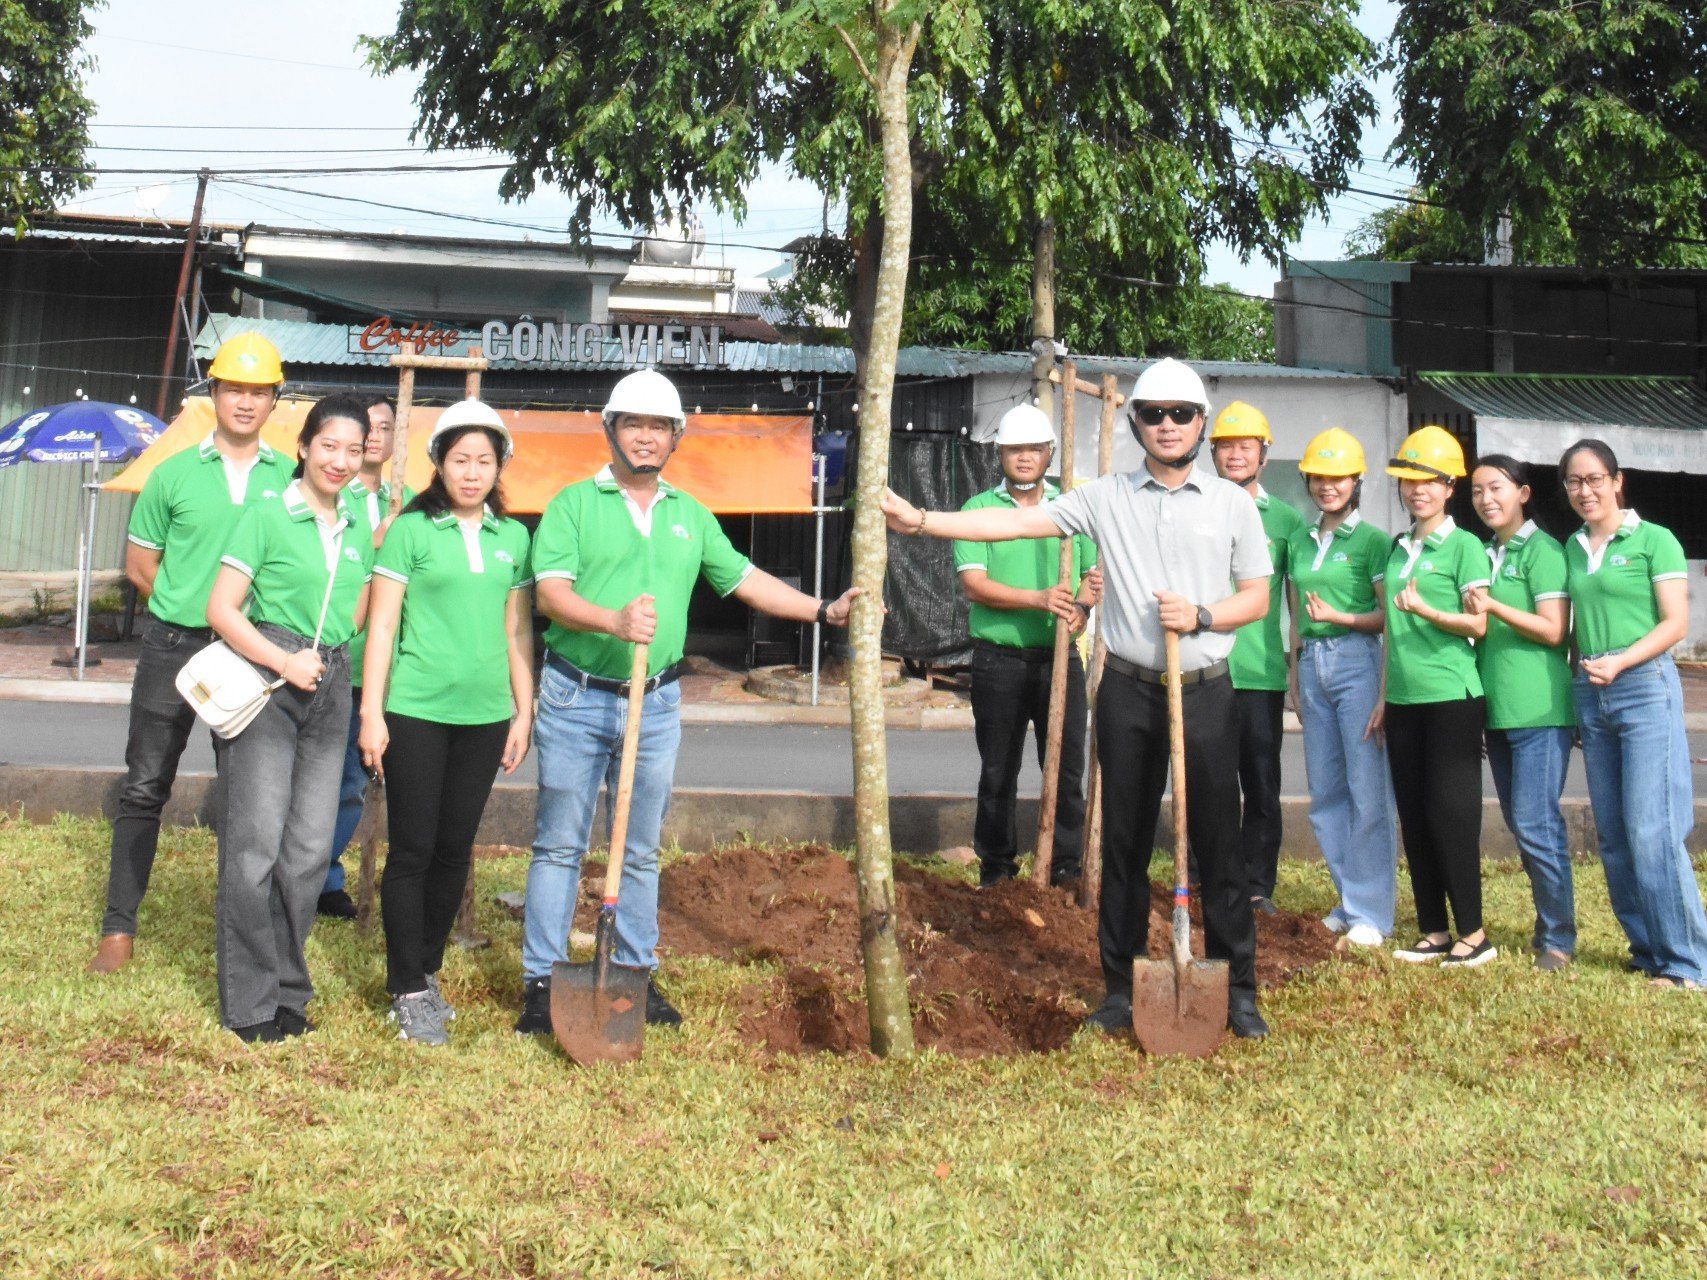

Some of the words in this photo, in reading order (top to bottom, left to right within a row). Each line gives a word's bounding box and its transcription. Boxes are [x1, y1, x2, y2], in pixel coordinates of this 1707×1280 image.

[360, 315, 458, 355] Coffee
[482, 314, 601, 363] CÔNG
[620, 318, 720, 365] VIÊN
[64, 451, 78, 460] ICE
[79, 450, 108, 459] CREM
